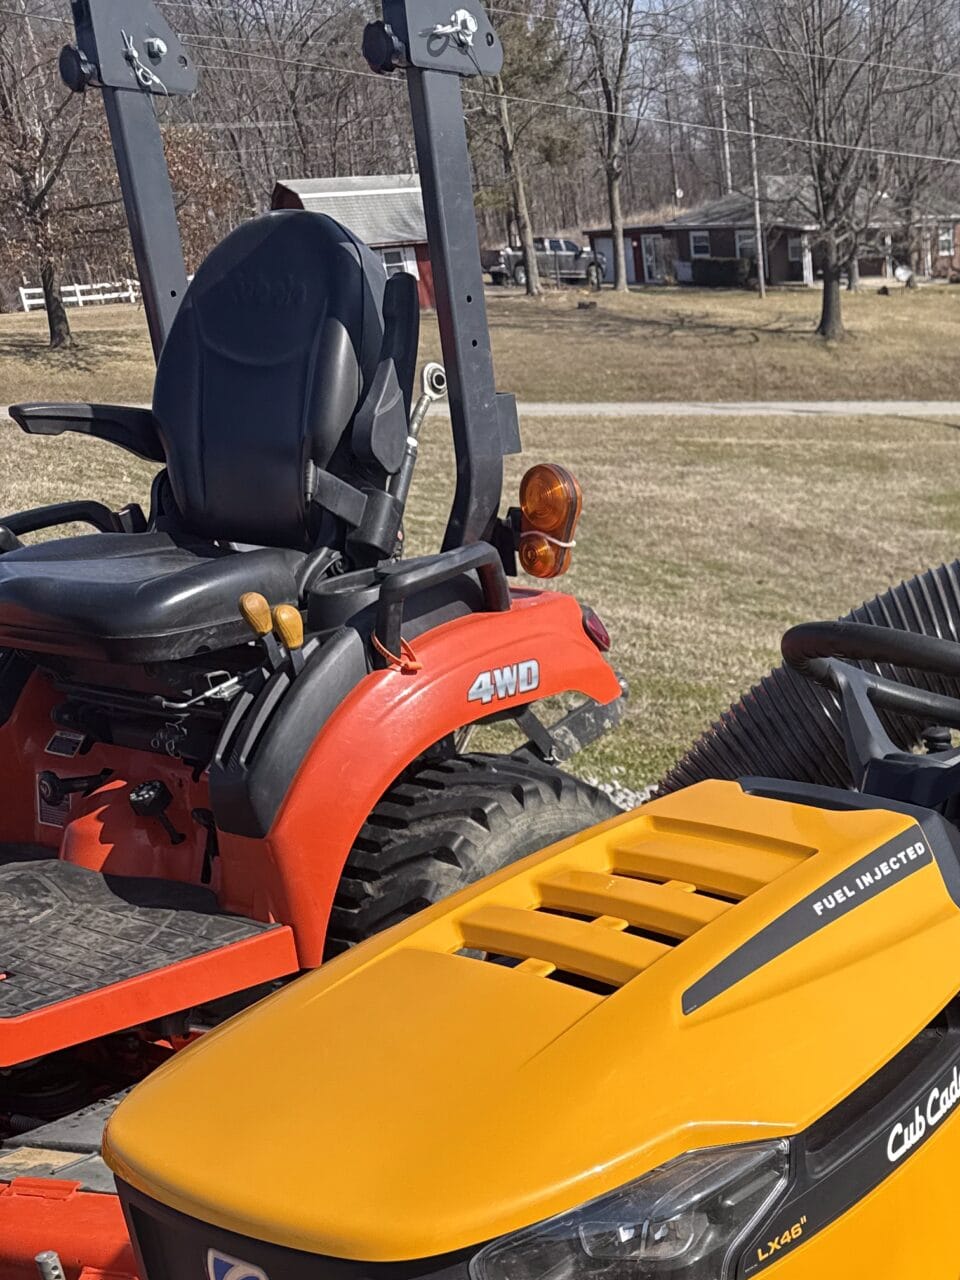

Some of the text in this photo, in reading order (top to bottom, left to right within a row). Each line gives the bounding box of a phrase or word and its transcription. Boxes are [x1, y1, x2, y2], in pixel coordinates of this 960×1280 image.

[467, 658, 540, 705] 4WD
[812, 841, 926, 916] FUEL INJECTED
[887, 1122, 926, 1162] Cub
[757, 1215, 807, 1261] LX46"
